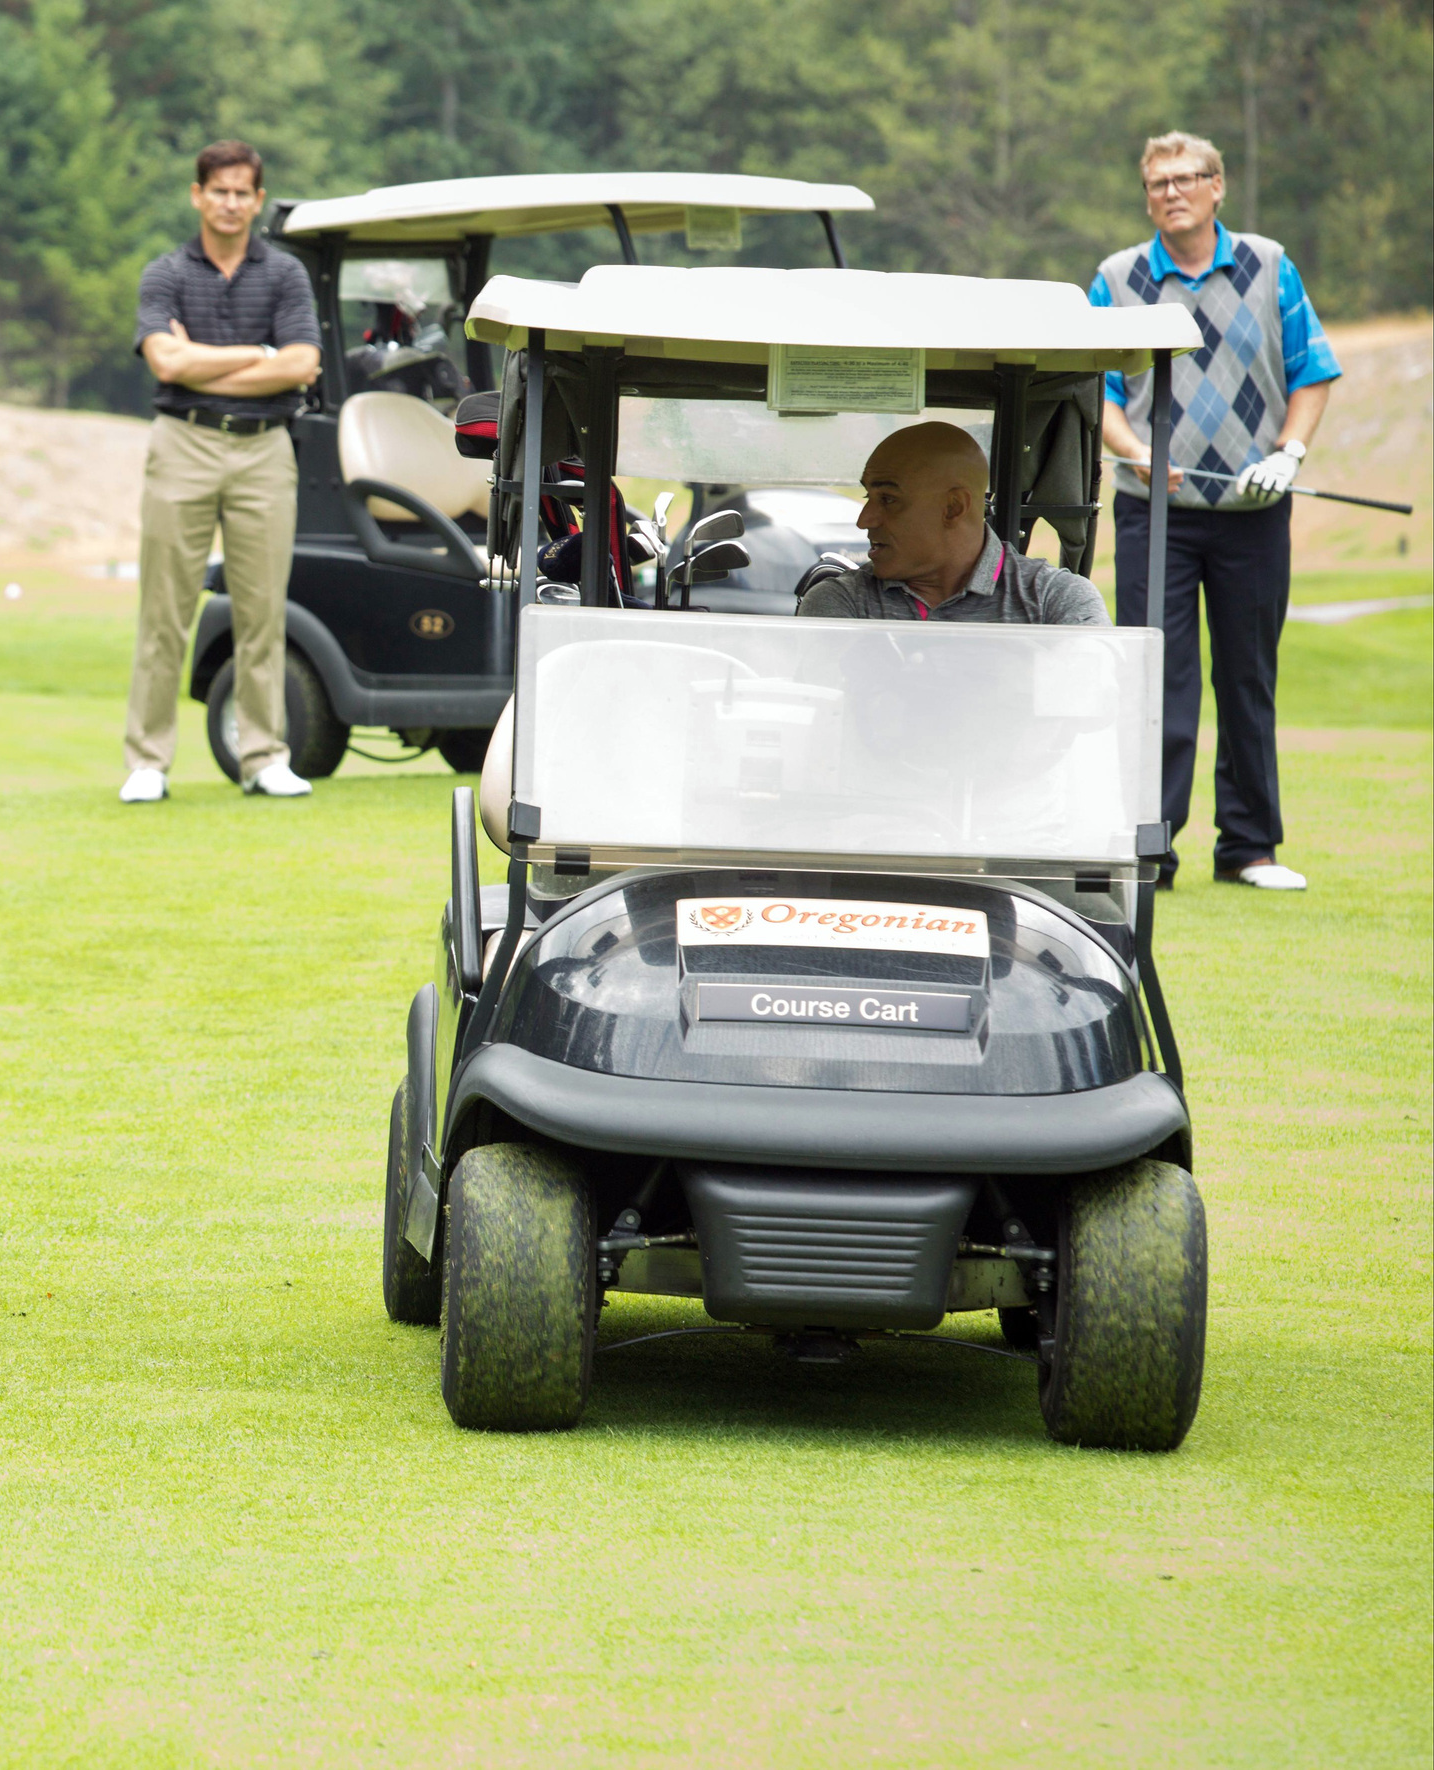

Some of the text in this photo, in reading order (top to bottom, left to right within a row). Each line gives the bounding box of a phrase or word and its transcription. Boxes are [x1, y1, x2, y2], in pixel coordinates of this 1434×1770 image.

[761, 904, 977, 935] Oregonian
[750, 993, 919, 1022] Course Cart
